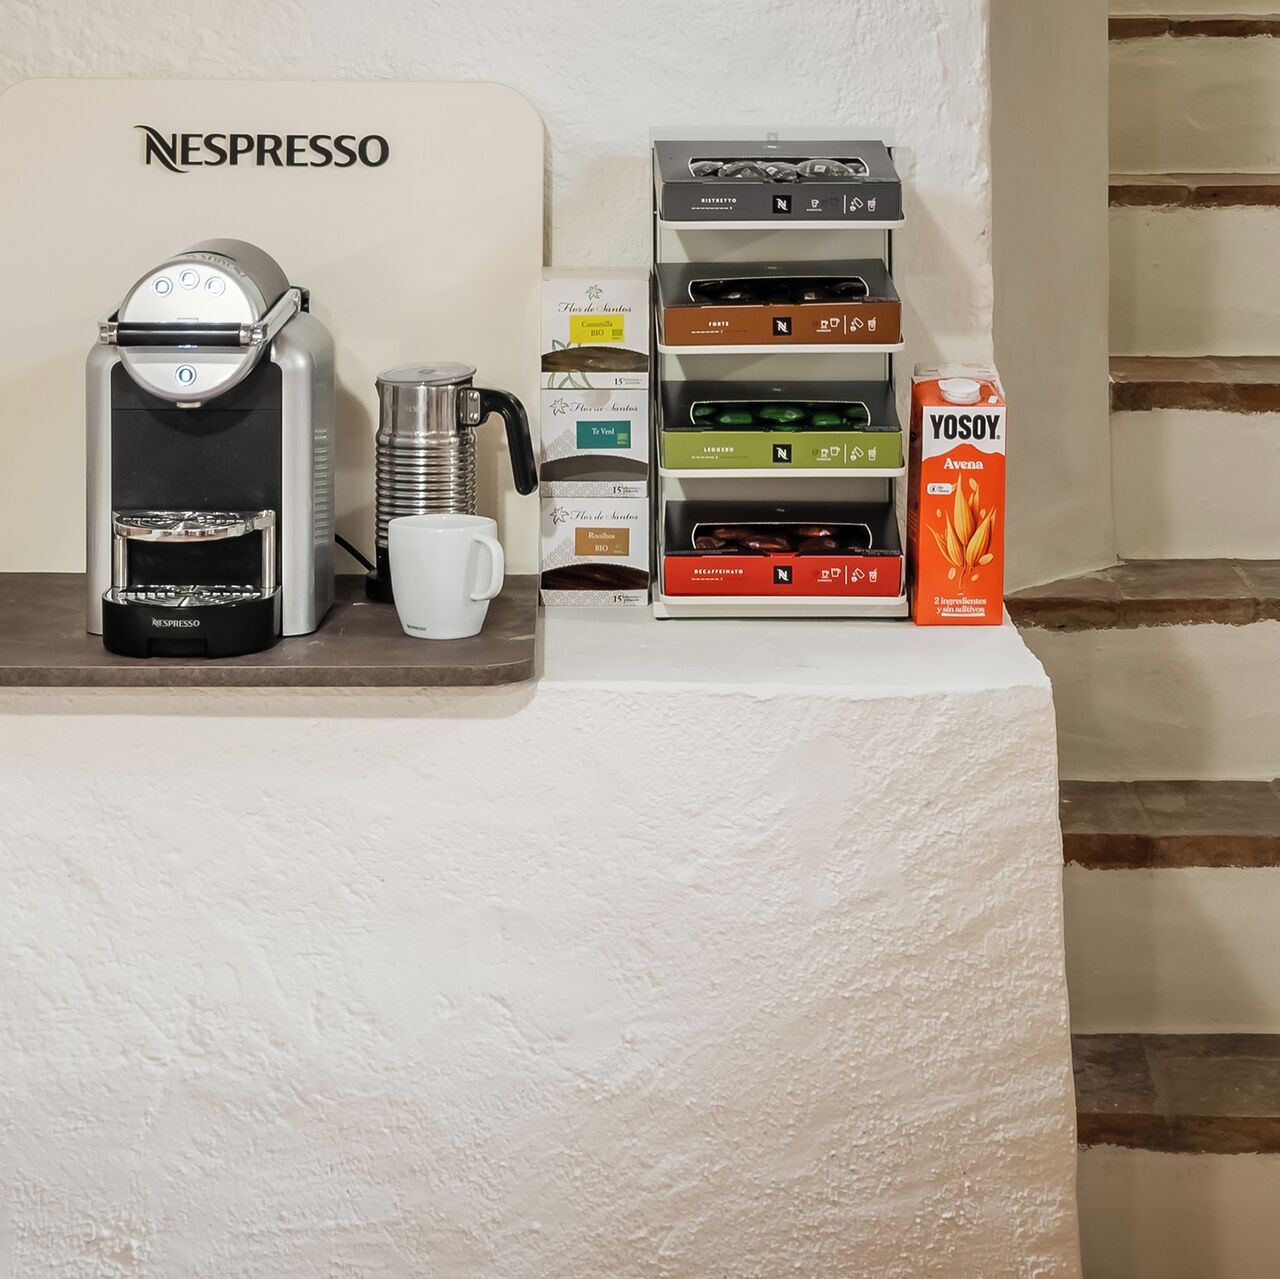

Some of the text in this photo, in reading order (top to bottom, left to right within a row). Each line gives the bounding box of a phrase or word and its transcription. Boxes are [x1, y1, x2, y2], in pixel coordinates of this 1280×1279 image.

[133, 124, 390, 174] NESPRESSO
[583, 302, 594, 313] de
[590, 329, 604, 337] BIO
[614, 377, 623, 385] 15
[943, 457, 984, 469] Avena
[613, 486, 621, 494] 15
[588, 531, 615, 539] Rooibos
[613, 595, 622, 603] 15
[934, 596, 940, 604] 2
[151, 617, 201, 628] NESPRESSO
